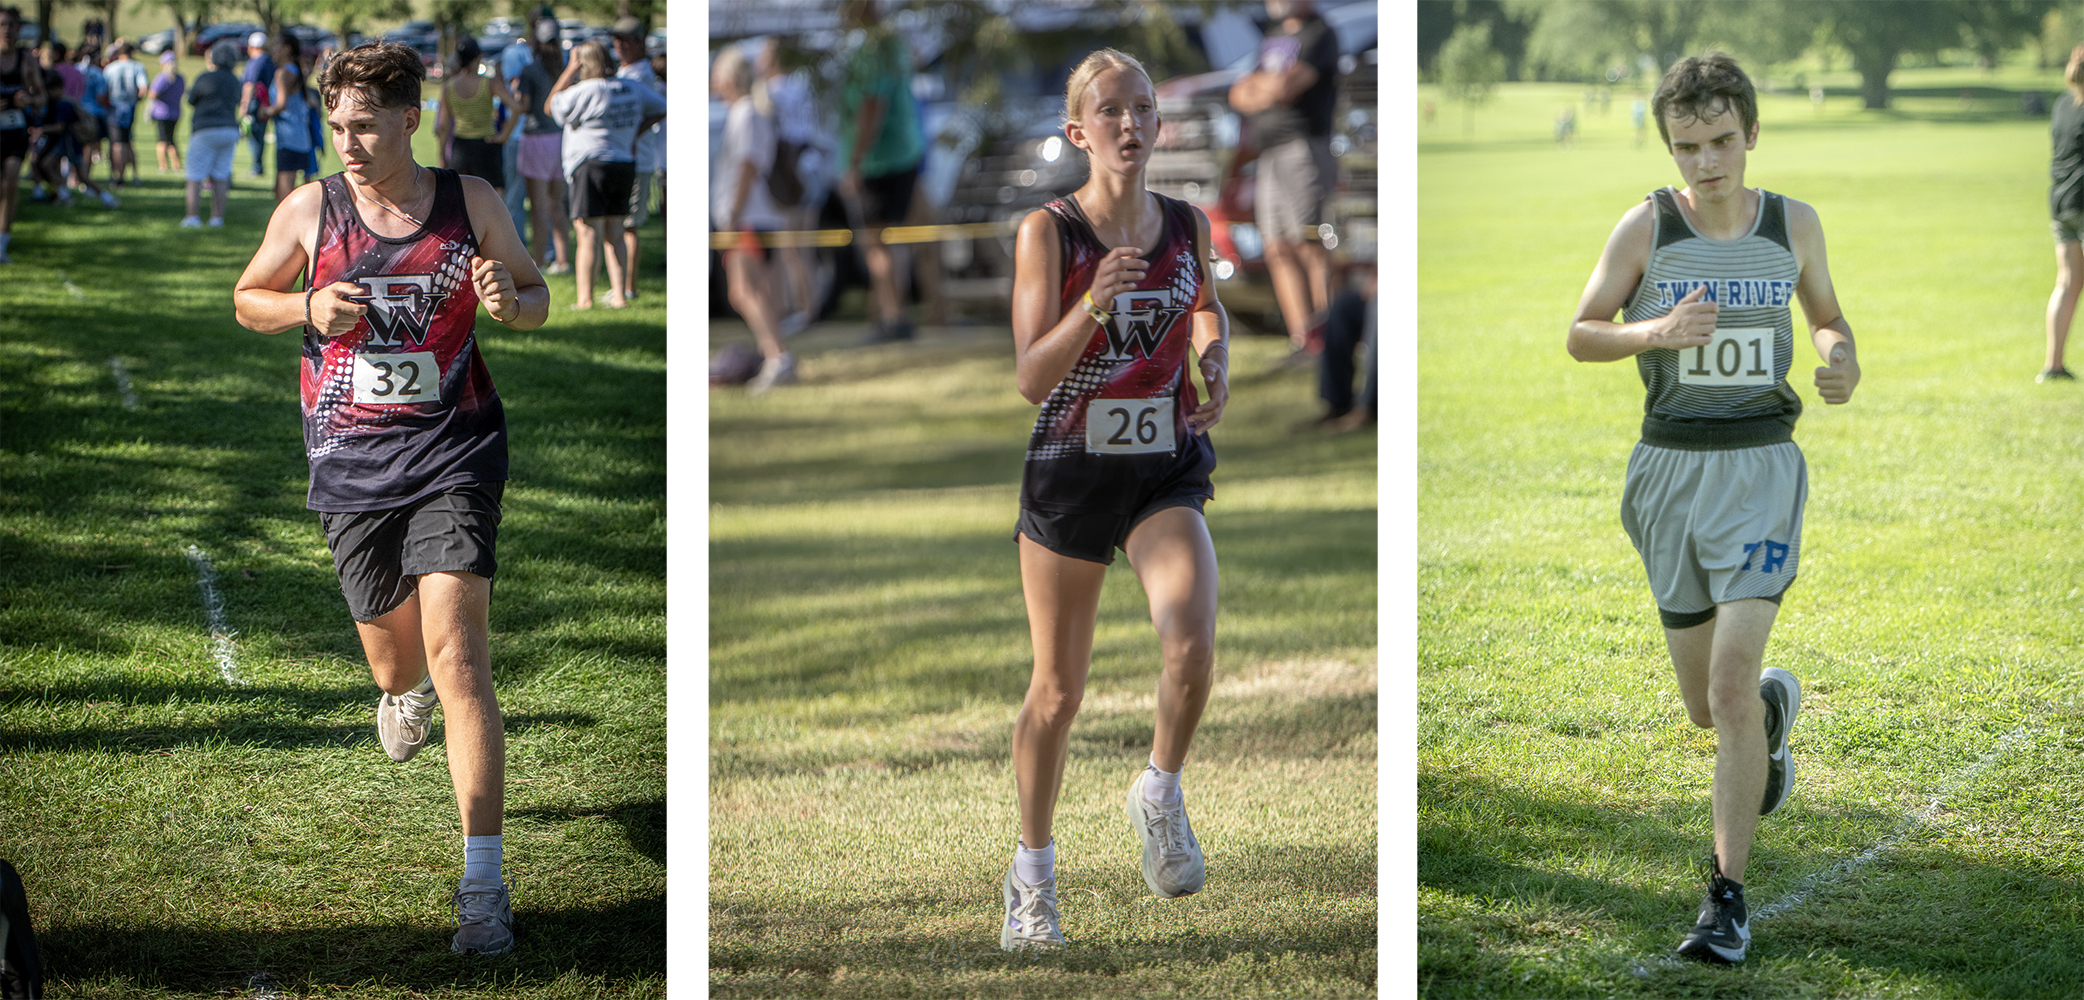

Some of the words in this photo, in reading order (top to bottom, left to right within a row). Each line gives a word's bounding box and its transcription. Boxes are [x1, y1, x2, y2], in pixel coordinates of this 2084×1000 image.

[1687, 337, 1768, 378] 101
[370, 360, 422, 397] 32
[1106, 406, 1158, 446] 26
